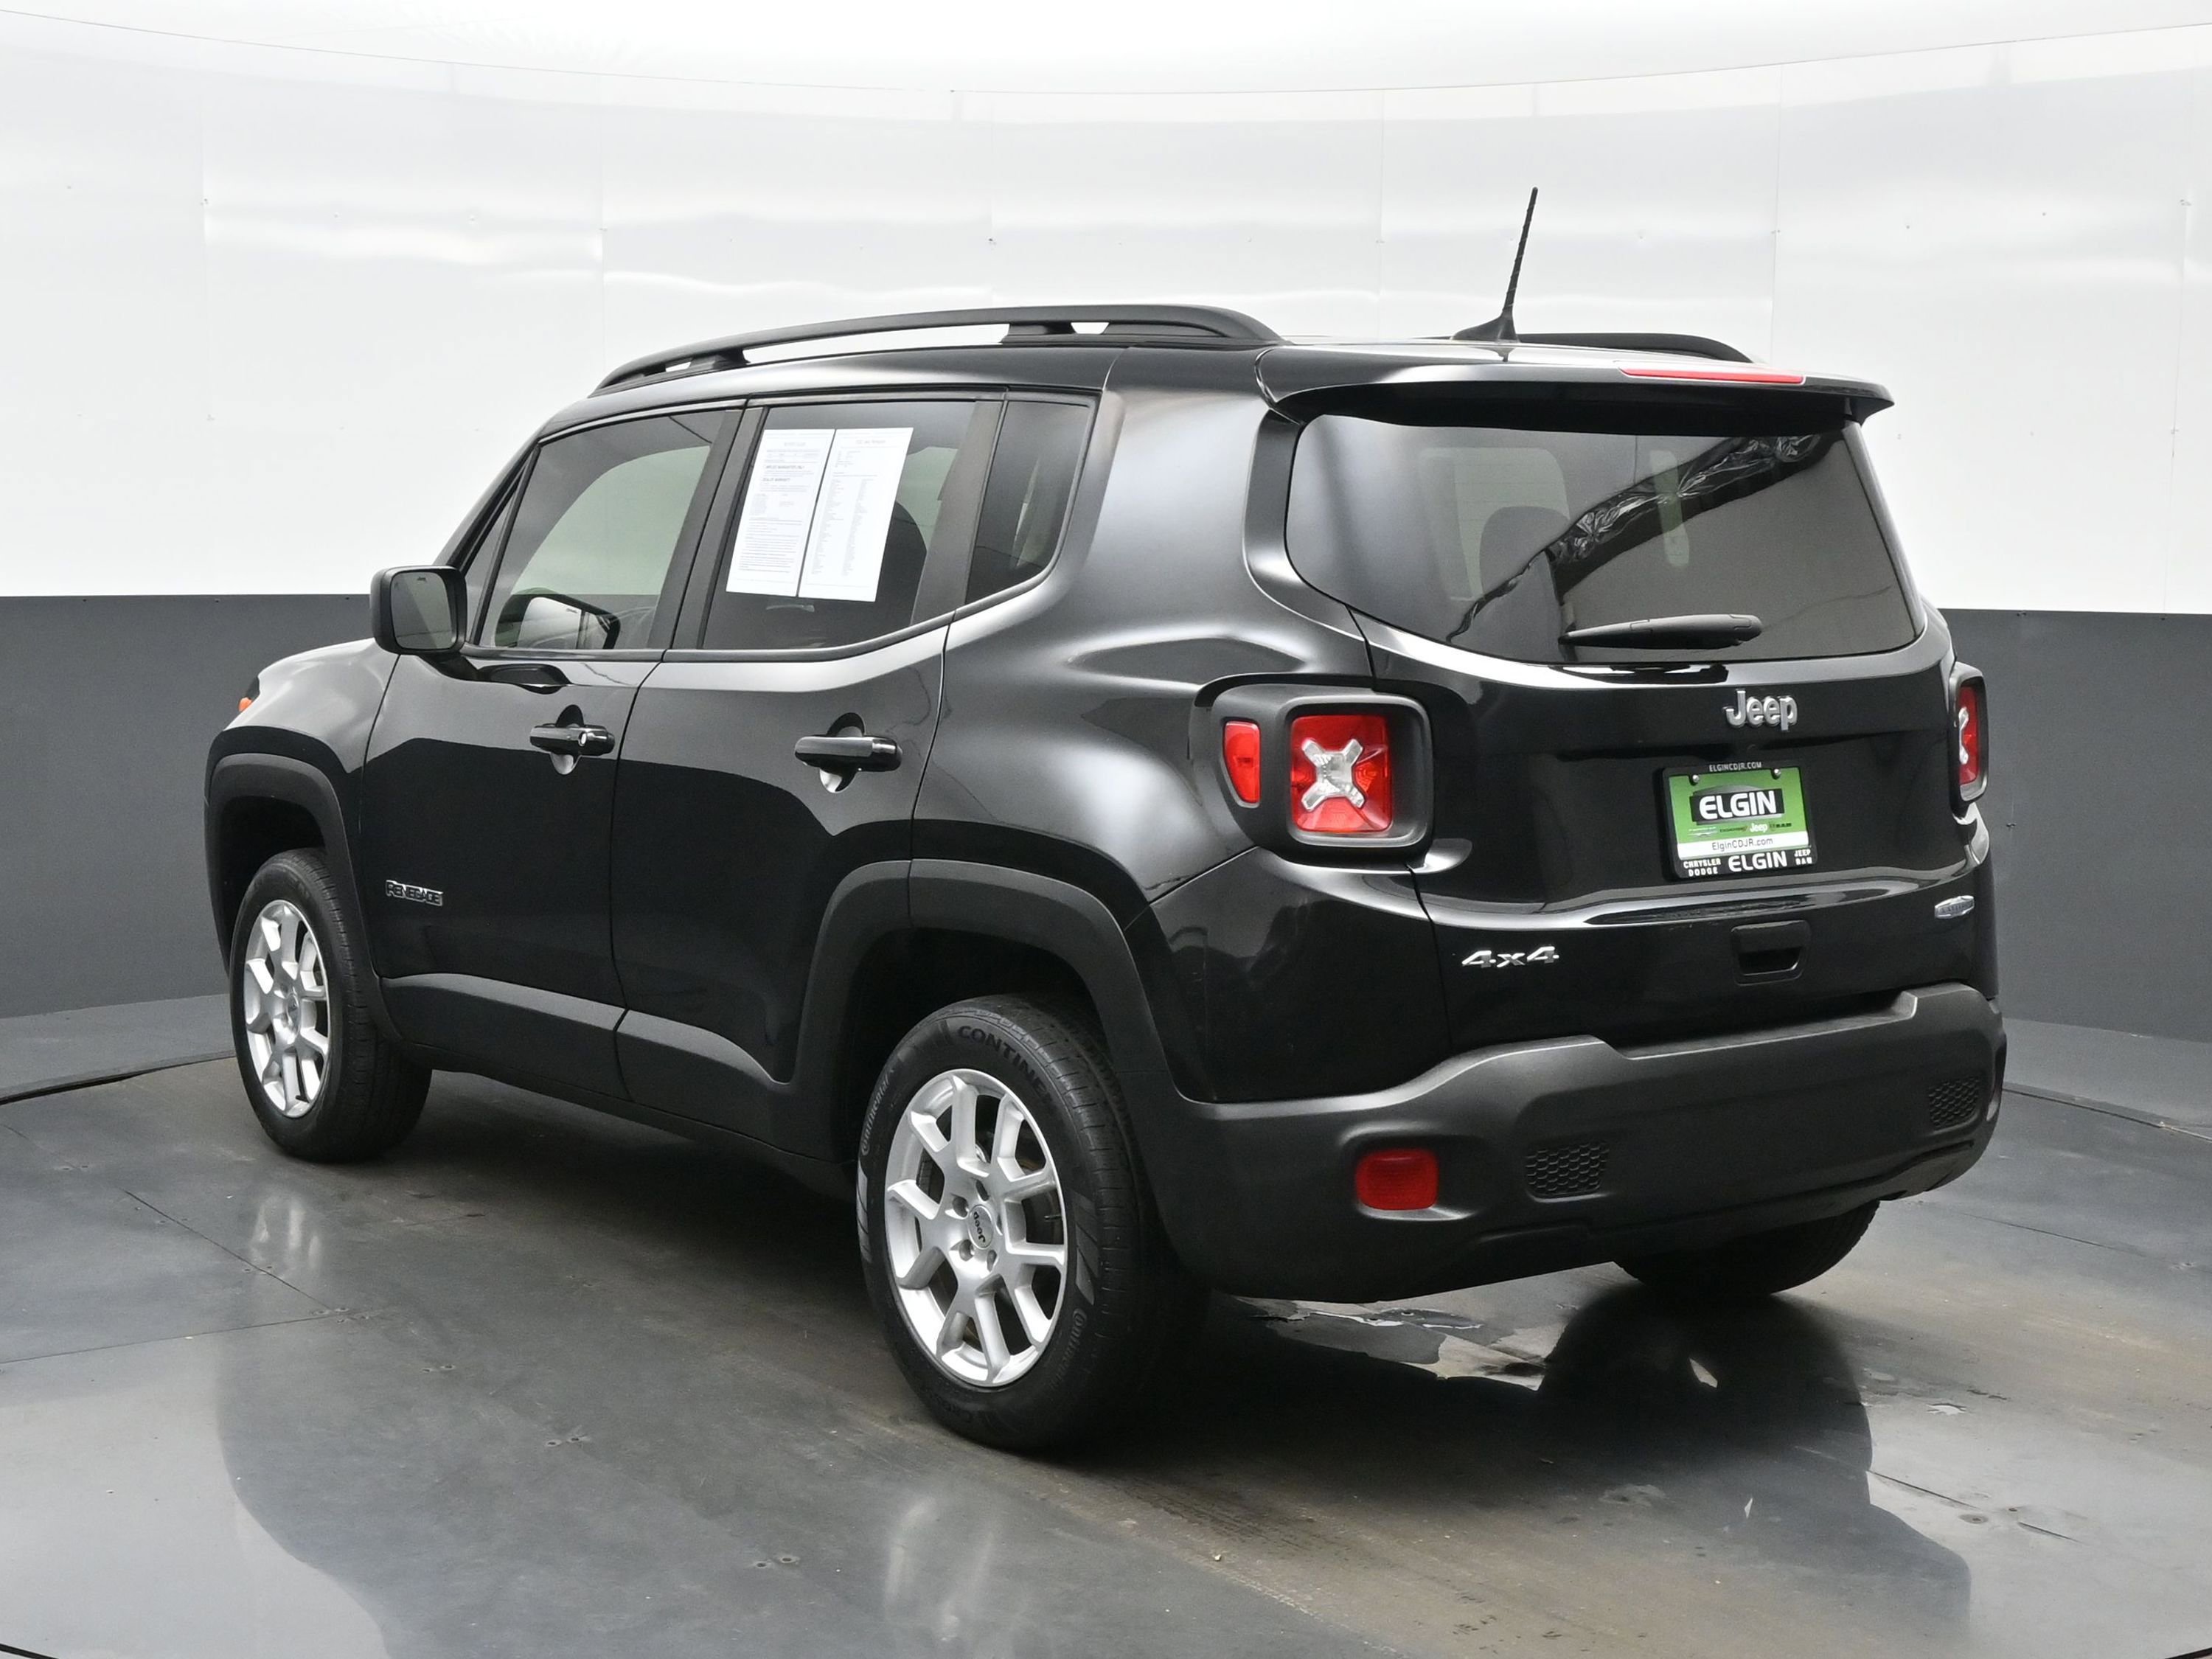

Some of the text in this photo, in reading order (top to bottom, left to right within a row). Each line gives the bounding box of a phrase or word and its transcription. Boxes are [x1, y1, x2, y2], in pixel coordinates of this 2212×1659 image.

[1722, 689, 1798, 731] Jeep
[1708, 762, 1761, 772] ELGINCDJR.COM
[1699, 790, 1777, 820] ELGIN
[1749, 822, 1768, 833] Jeep
[1711, 838, 1773, 852] ElginCDJR.com
[1683, 849, 1811, 873] CHRYSLER ELGIN JEEP
[1688, 866, 1718, 877] DODGE
